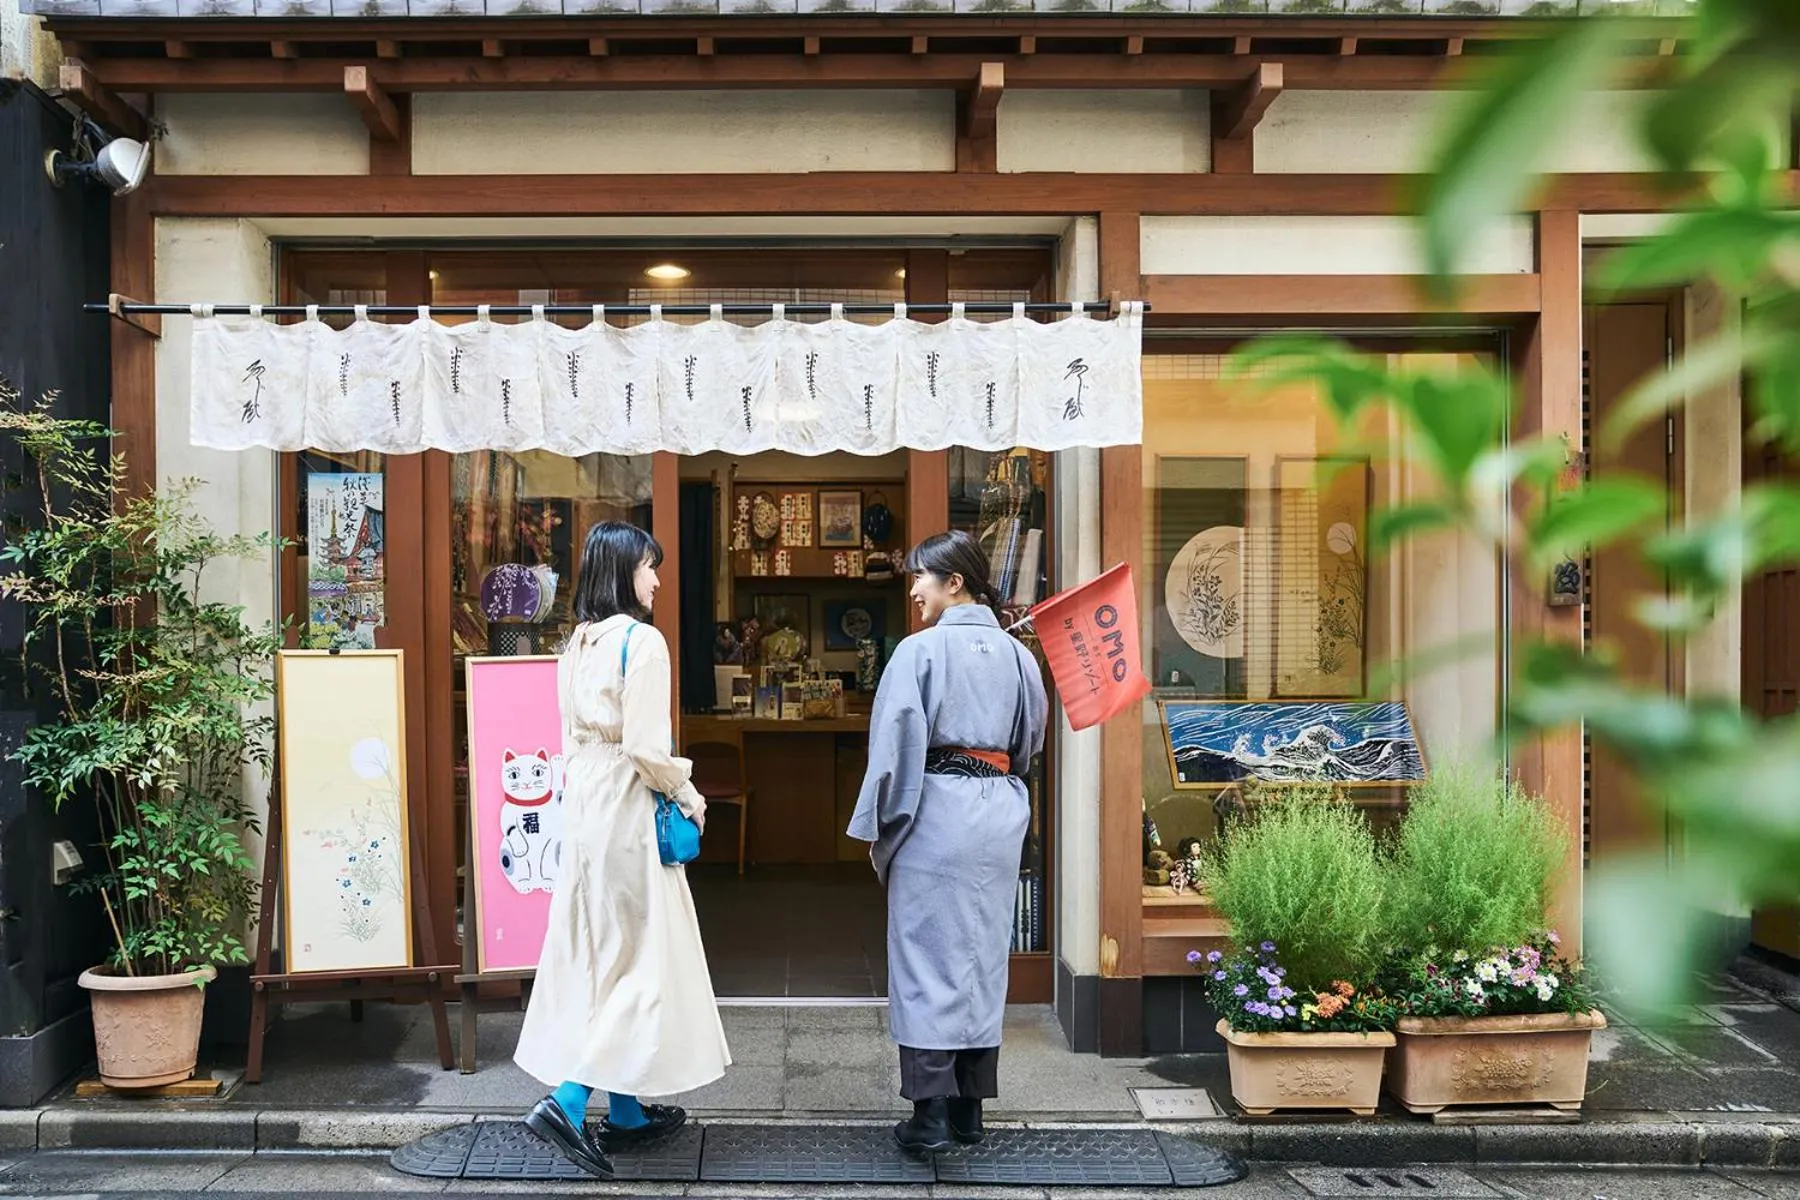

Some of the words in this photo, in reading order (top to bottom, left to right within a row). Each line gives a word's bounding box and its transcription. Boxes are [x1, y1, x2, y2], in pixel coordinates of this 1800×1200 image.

[969, 642, 995, 652] OMO
[1063, 616, 1075, 631] by
[1070, 630, 1102, 696] 星野リゾート
[1093, 604, 1128, 683] OMO
[522, 811, 540, 835] 福
